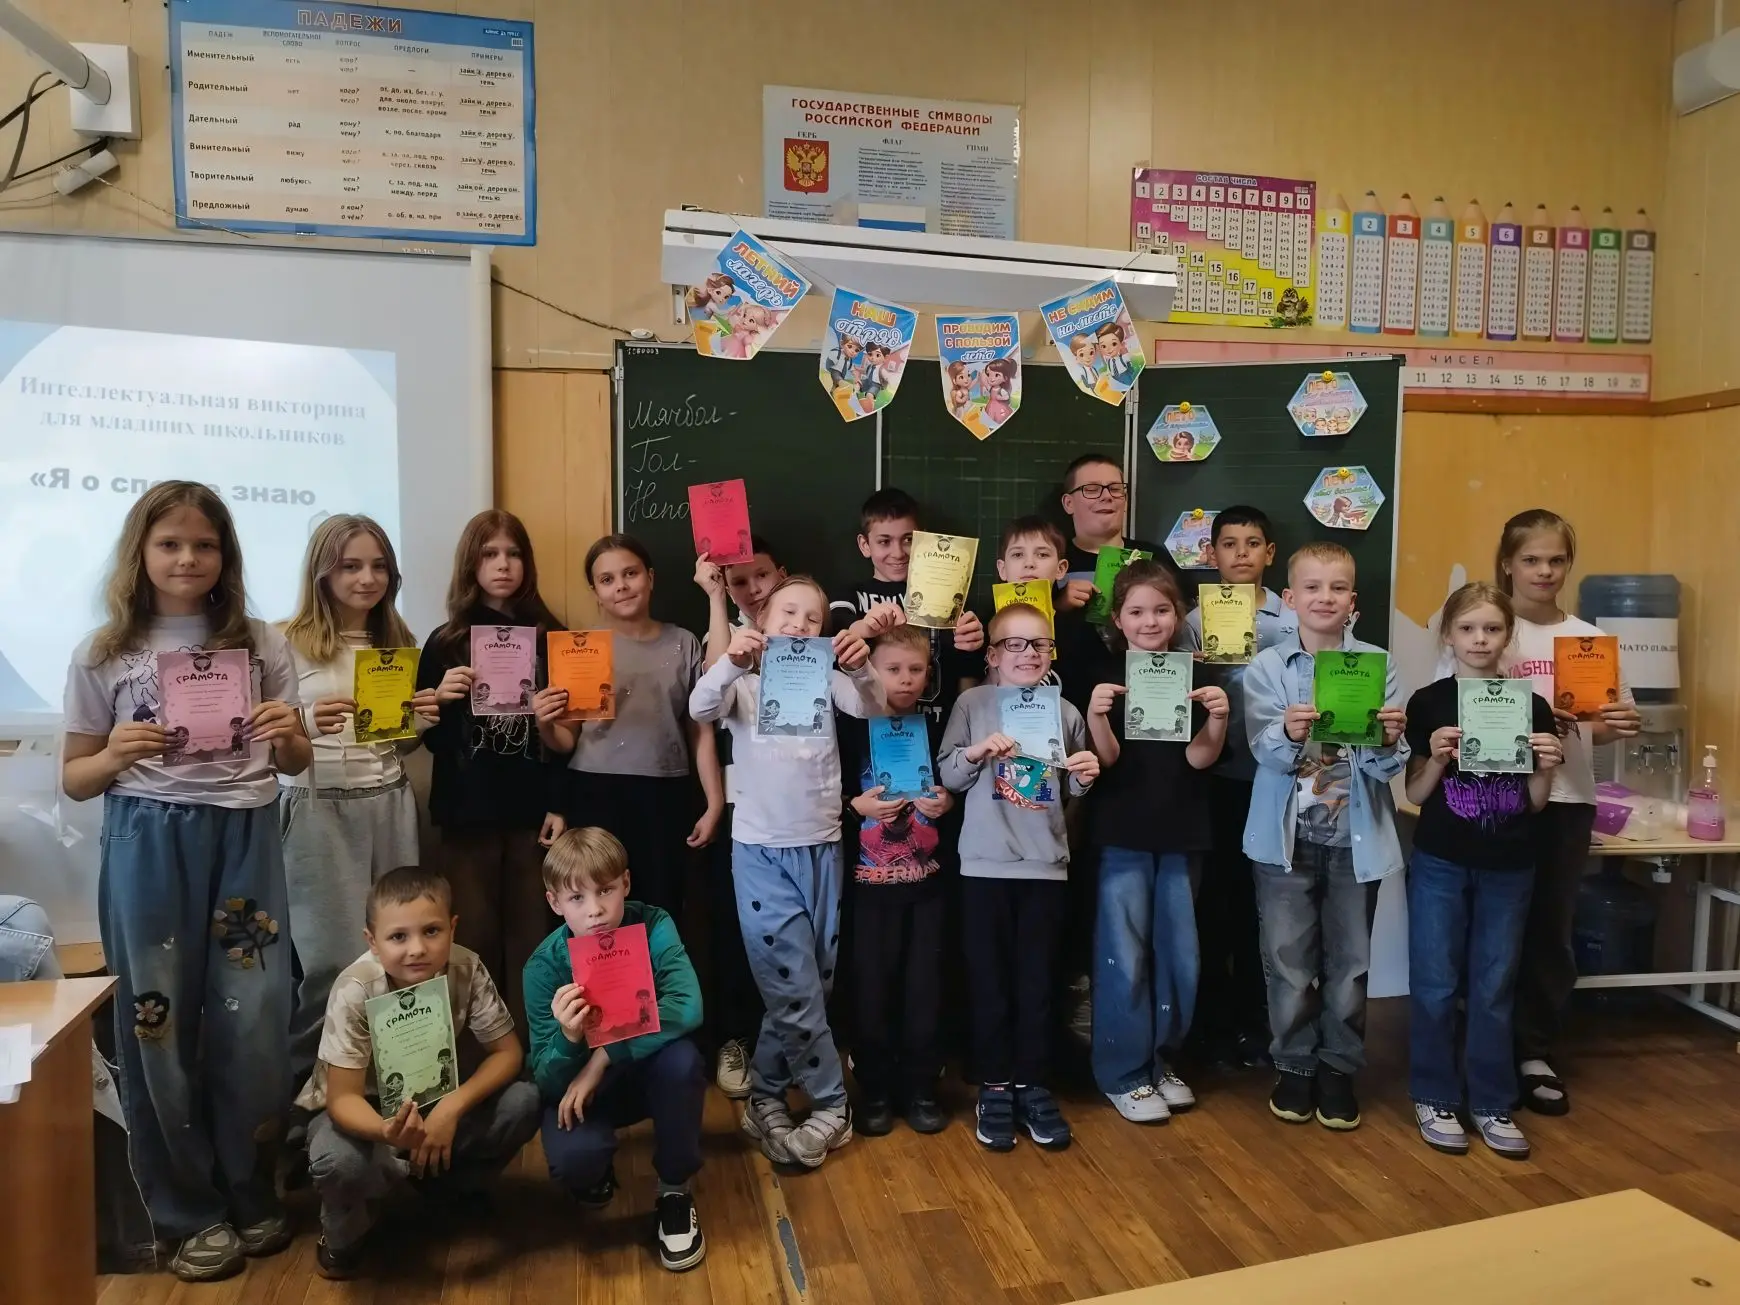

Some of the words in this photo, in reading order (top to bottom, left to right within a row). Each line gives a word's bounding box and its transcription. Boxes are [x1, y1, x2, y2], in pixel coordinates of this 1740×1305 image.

[297, 9, 402, 33] ПАДЕЖИ
[208, 30, 234, 38] ПАДЕЖ
[187, 50, 255, 62] Именительный
[471, 52, 503, 61] ПРИМЕРЫ
[188, 81, 248, 92] Родительный
[791, 98, 920, 119] ГОСУДАРСТВЕННЫЕ
[928, 110, 993, 125] СИМВОЛЫ
[188, 114, 238, 125] Дательный
[288, 121, 301, 129] рад
[805, 113, 892, 129] РОССИЙСКОЙ
[901, 121, 980, 137] ФЕДЕРАЦИИ
[797, 131, 817, 139] ГЕРБ
[189, 142, 251, 154] Винительный
[190, 171, 255, 183] Творительный
[1196, 174, 1229, 185] СОСТАВ
[1231, 176, 1257, 186] ЧИСЛА
[1141, 186, 1146, 195] 1
[1158, 187, 1164, 196] 2
[1177, 188, 1183, 197] 3
[1195, 189, 1201, 198] 4
[1214, 190, 1220, 199] 5
[1232, 191, 1238, 200] 6
[1249, 193, 1255, 202] 7
[1266, 194, 1272, 203] 8
[1283, 195, 1289, 205] 9
[1298, 197, 1309, 206] 10
[192, 200, 250, 212] Предложный
[1332, 218, 1337, 226] 1
[1367, 221, 1373, 229] 2
[1139, 225, 1149, 235] 11
[1435, 226, 1441, 234] 4
[1470, 228, 1475, 236] 5
[1504, 231, 1510, 239] 6
[1156, 235, 1167, 244] 12
[1174, 245, 1185, 254] 13
[1193, 255, 1203, 264] 14
[732, 241, 801, 299] ЛЕТНИЙ
[1211, 264, 1222, 273] 15
[726, 258, 784, 307] лагерь
[1228, 273, 1239, 282] 16
[1245, 282, 1255, 291] 17
[1262, 291, 1273, 300] 18
[1047, 307, 1067, 324] НЕ
[1067, 287, 1115, 315] СИДИМ
[851, 300, 897, 328] НАШ
[835, 318, 903, 348] отряд
[943, 323, 1011, 335] ПРОВОДИМ
[1056, 323, 1076, 338] на
[945, 337, 954, 349] С
[955, 333, 1011, 348] ПОЛЬЗОЙ
[1430, 354, 1495, 366] ЧИСЕЛ
[1416, 372, 1427, 383] 11
[1441, 372, 1452, 383] 12
[1466, 373, 1477, 384] 13
[1490, 374, 1500, 385] 14
[1513, 375, 1525, 385] 15
[1536, 375, 1547, 386] 16
[1560, 376, 1570, 387] 17
[1583, 377, 1594, 387] 18
[1607, 377, 1619, 388] 19
[1629, 378, 1641, 388] 20
[19, 376, 241, 410] Интеллектуальная
[247, 397, 367, 421] викторина
[39, 410, 82, 427] для
[90, 413, 196, 435] младших
[203, 422, 346, 446] школьников
[29, 468, 70, 490] «Я
[81, 474, 100, 490] о
[231, 483, 316, 506] знаю
[923, 551, 961, 563] ГРАМОТА
[484, 642, 522, 651] ГРАМОТА
[775, 654, 817, 664] ГРАМОТА
[1567, 652, 1605, 660] ГРАМОТА
[367, 665, 404, 674] ГРАМОТА
[1138, 667, 1177, 676] ГРАМОТА
[176, 672, 228, 684] ГРАМОТА
[1473, 696, 1516, 705] ГРАМОТА
[1009, 703, 1046, 711] ГРАМОТА
[586, 948, 631, 966] ГРАМОТА
[385, 1005, 432, 1029] ГРАМОТА
